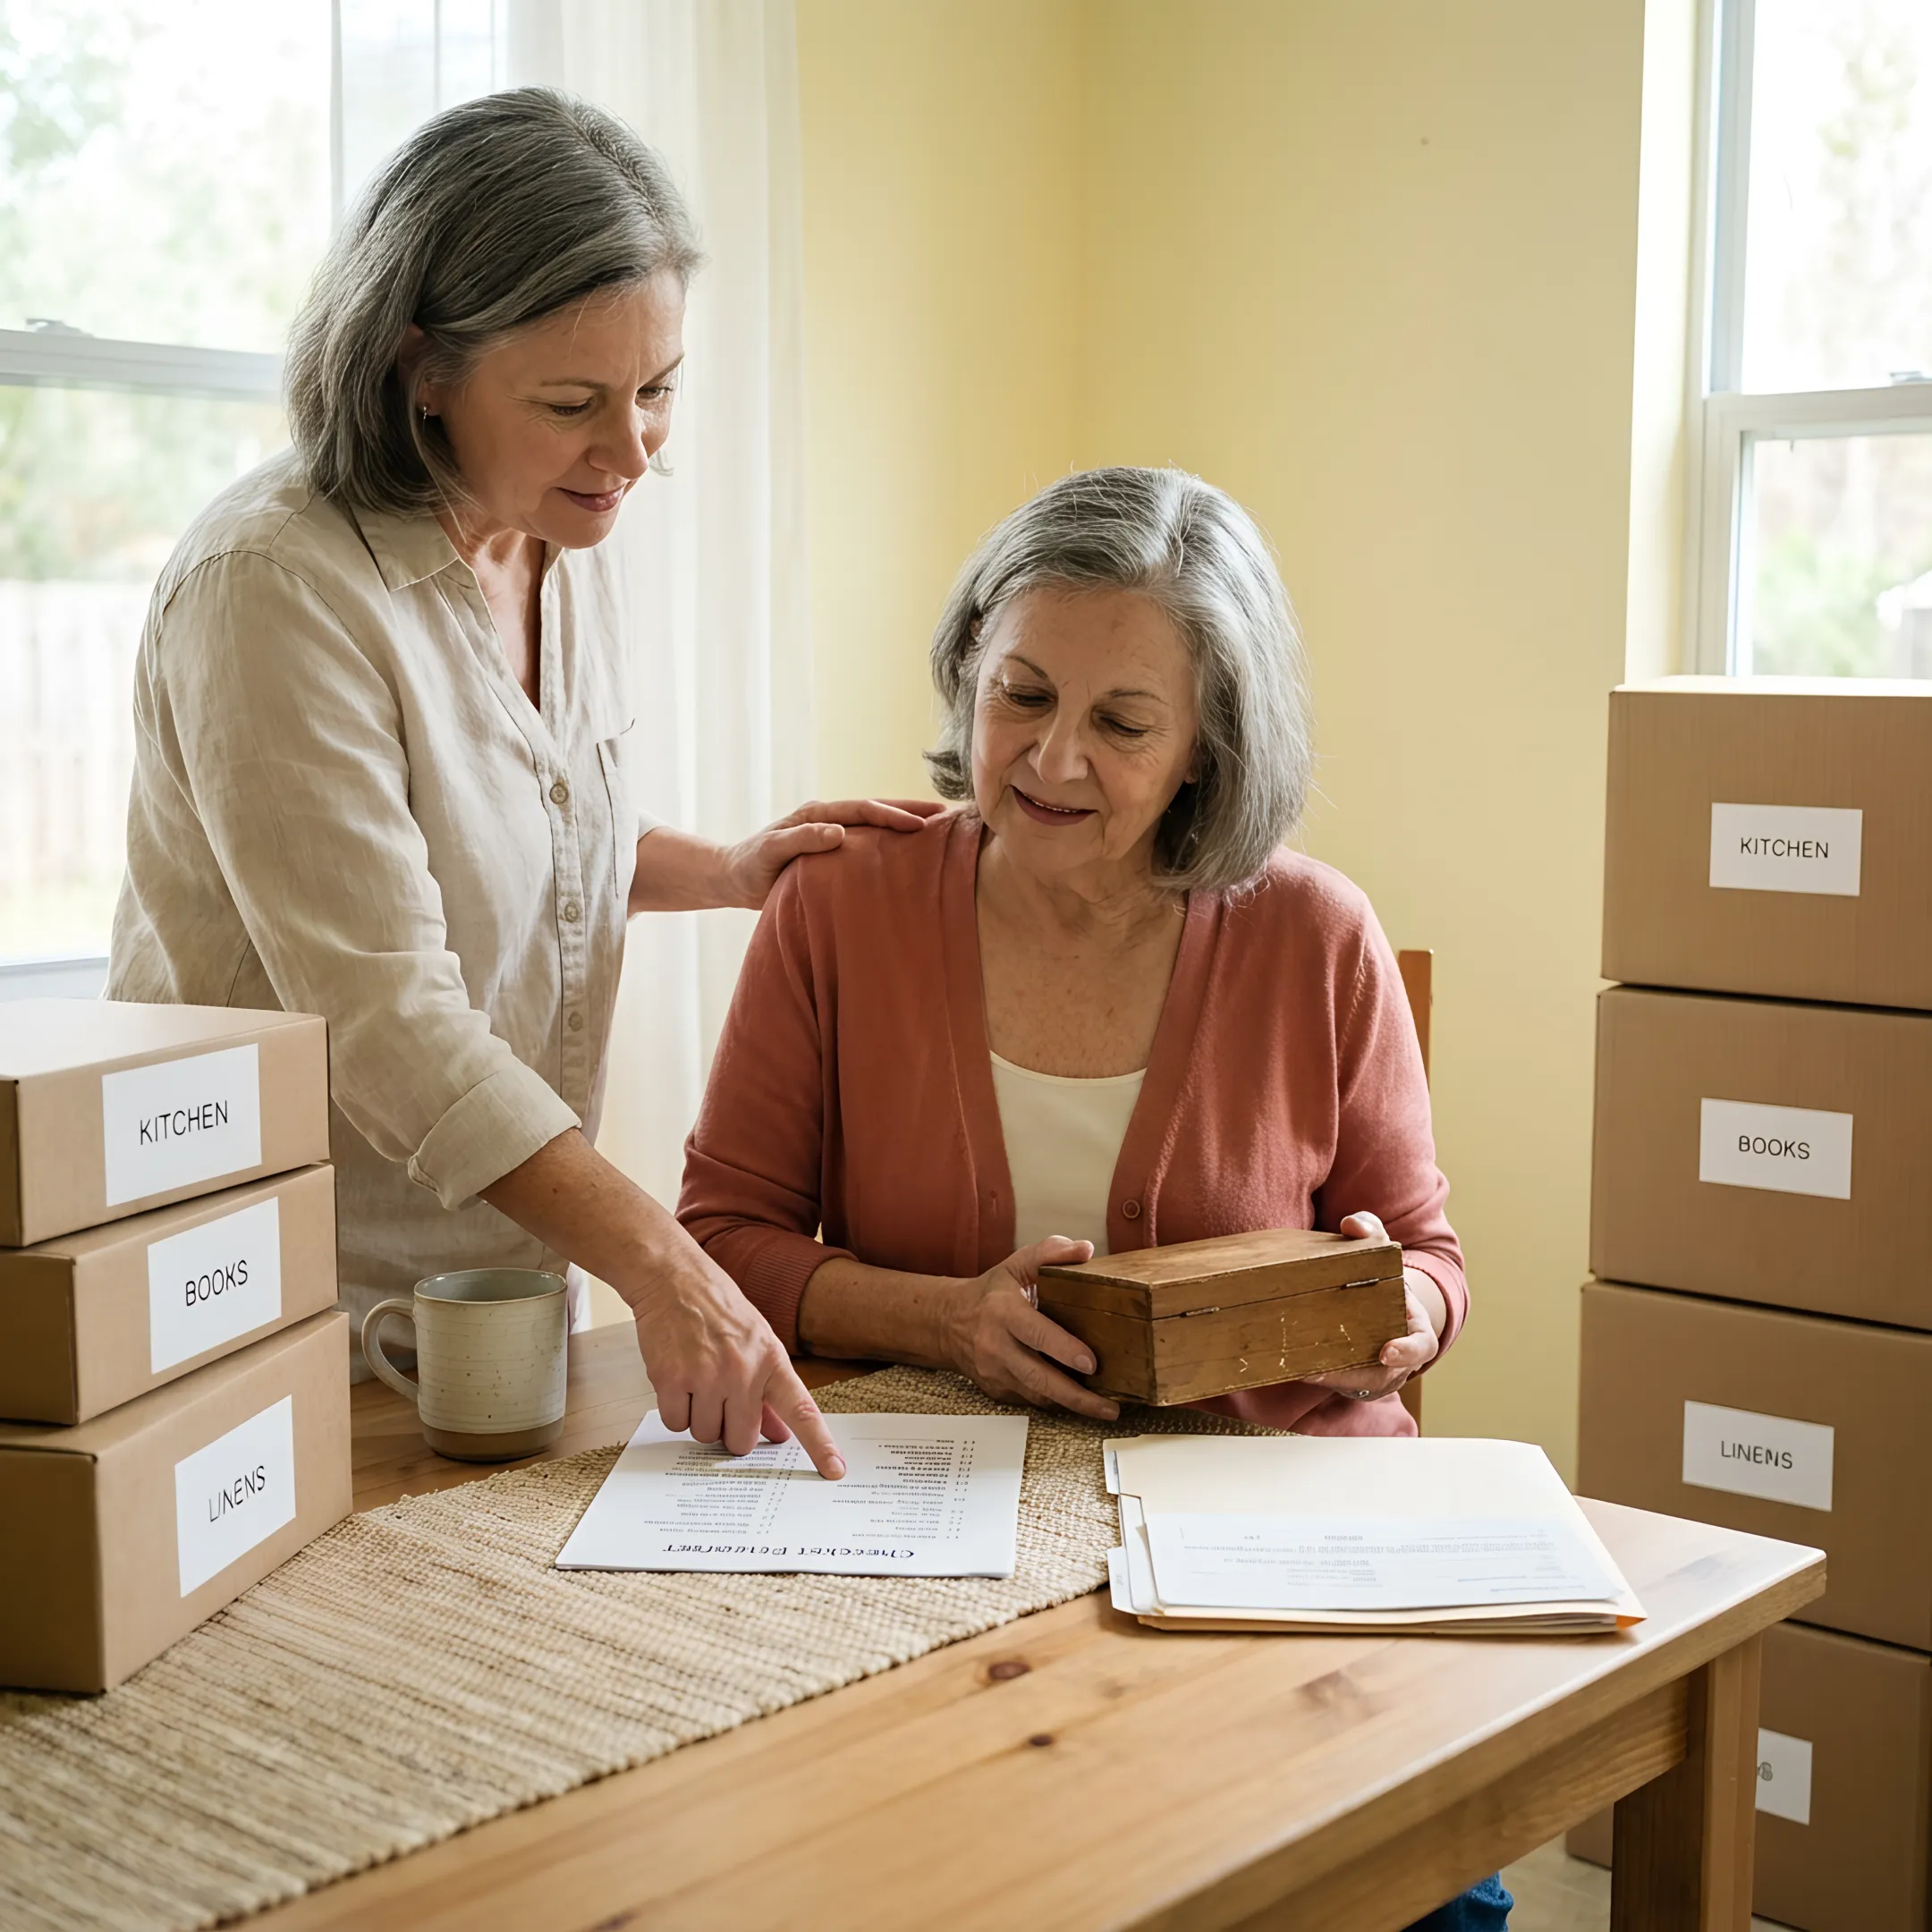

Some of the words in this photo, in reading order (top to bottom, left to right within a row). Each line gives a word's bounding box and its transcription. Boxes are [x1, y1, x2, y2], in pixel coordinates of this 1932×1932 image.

[1740, 835, 1829, 860] KITCHEN
[140, 1098, 229, 1146] KITCHEN
[1738, 1134, 1810, 1160] BOOKS
[185, 1259, 249, 1307] BOOKS
[1721, 1440, 1793, 1470] LINENS
[208, 1464, 266, 1522] LINENS
